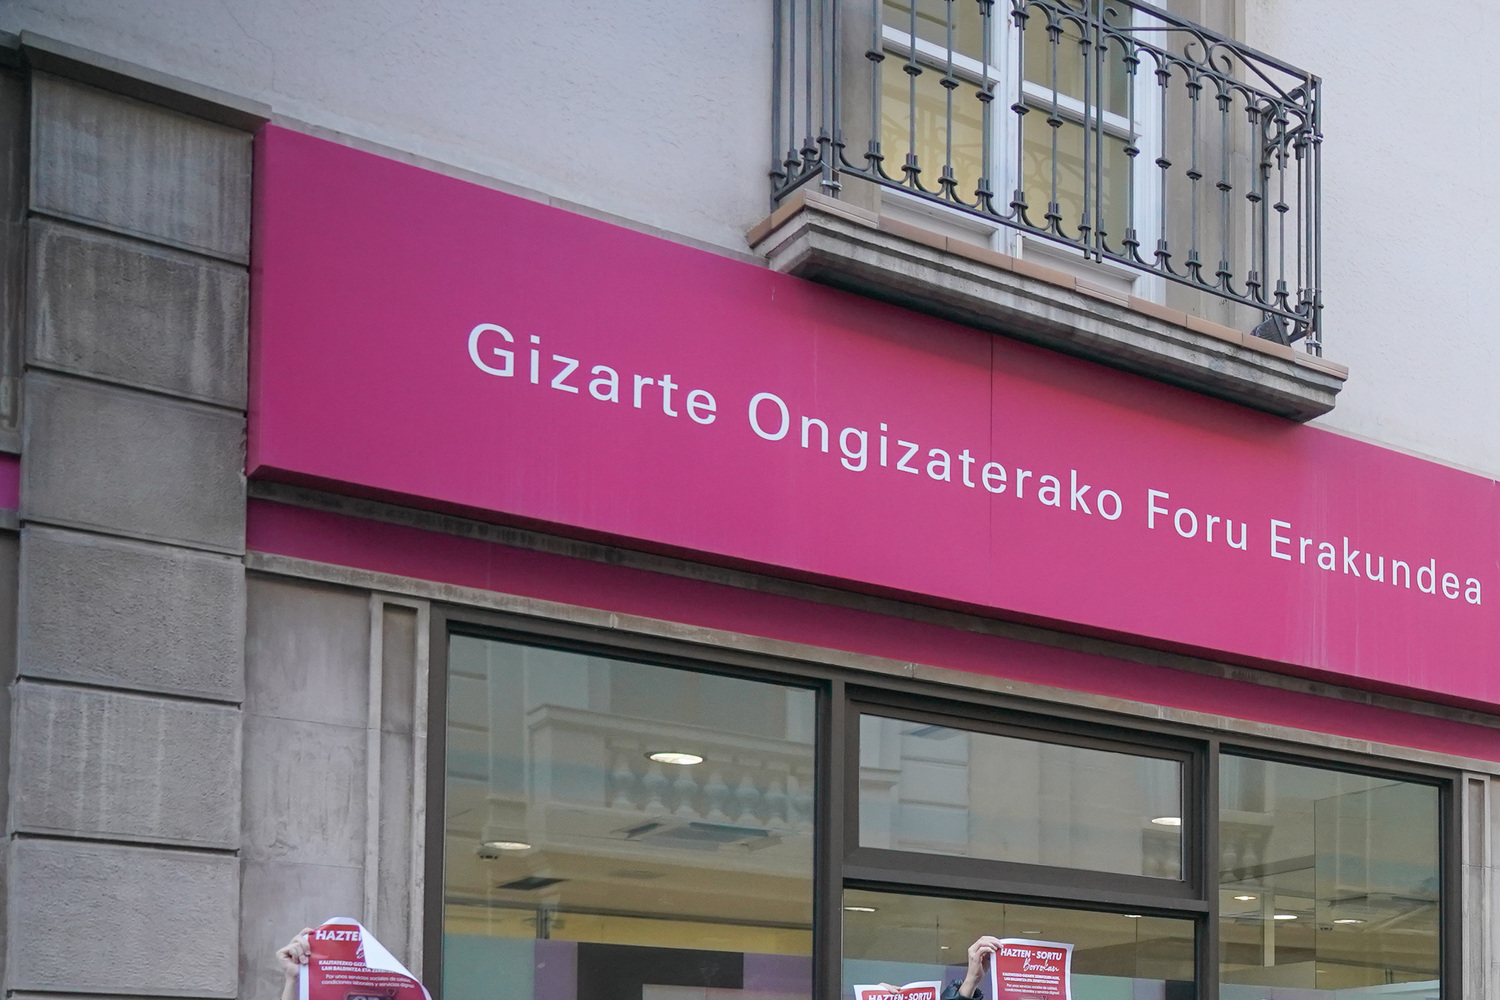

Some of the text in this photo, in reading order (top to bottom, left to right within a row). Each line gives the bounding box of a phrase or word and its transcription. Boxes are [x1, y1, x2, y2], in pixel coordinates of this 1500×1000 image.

[467, 322, 1482, 606] Gizarte Ongizaterako Foru Erakundea
[316, 930, 362, 941] HAZTE
[1001, 949, 1062, 960] HAZTEN SORTU
[1023, 958, 1059, 972] Borrokan
[909, 992, 932, 1000] SORTU
